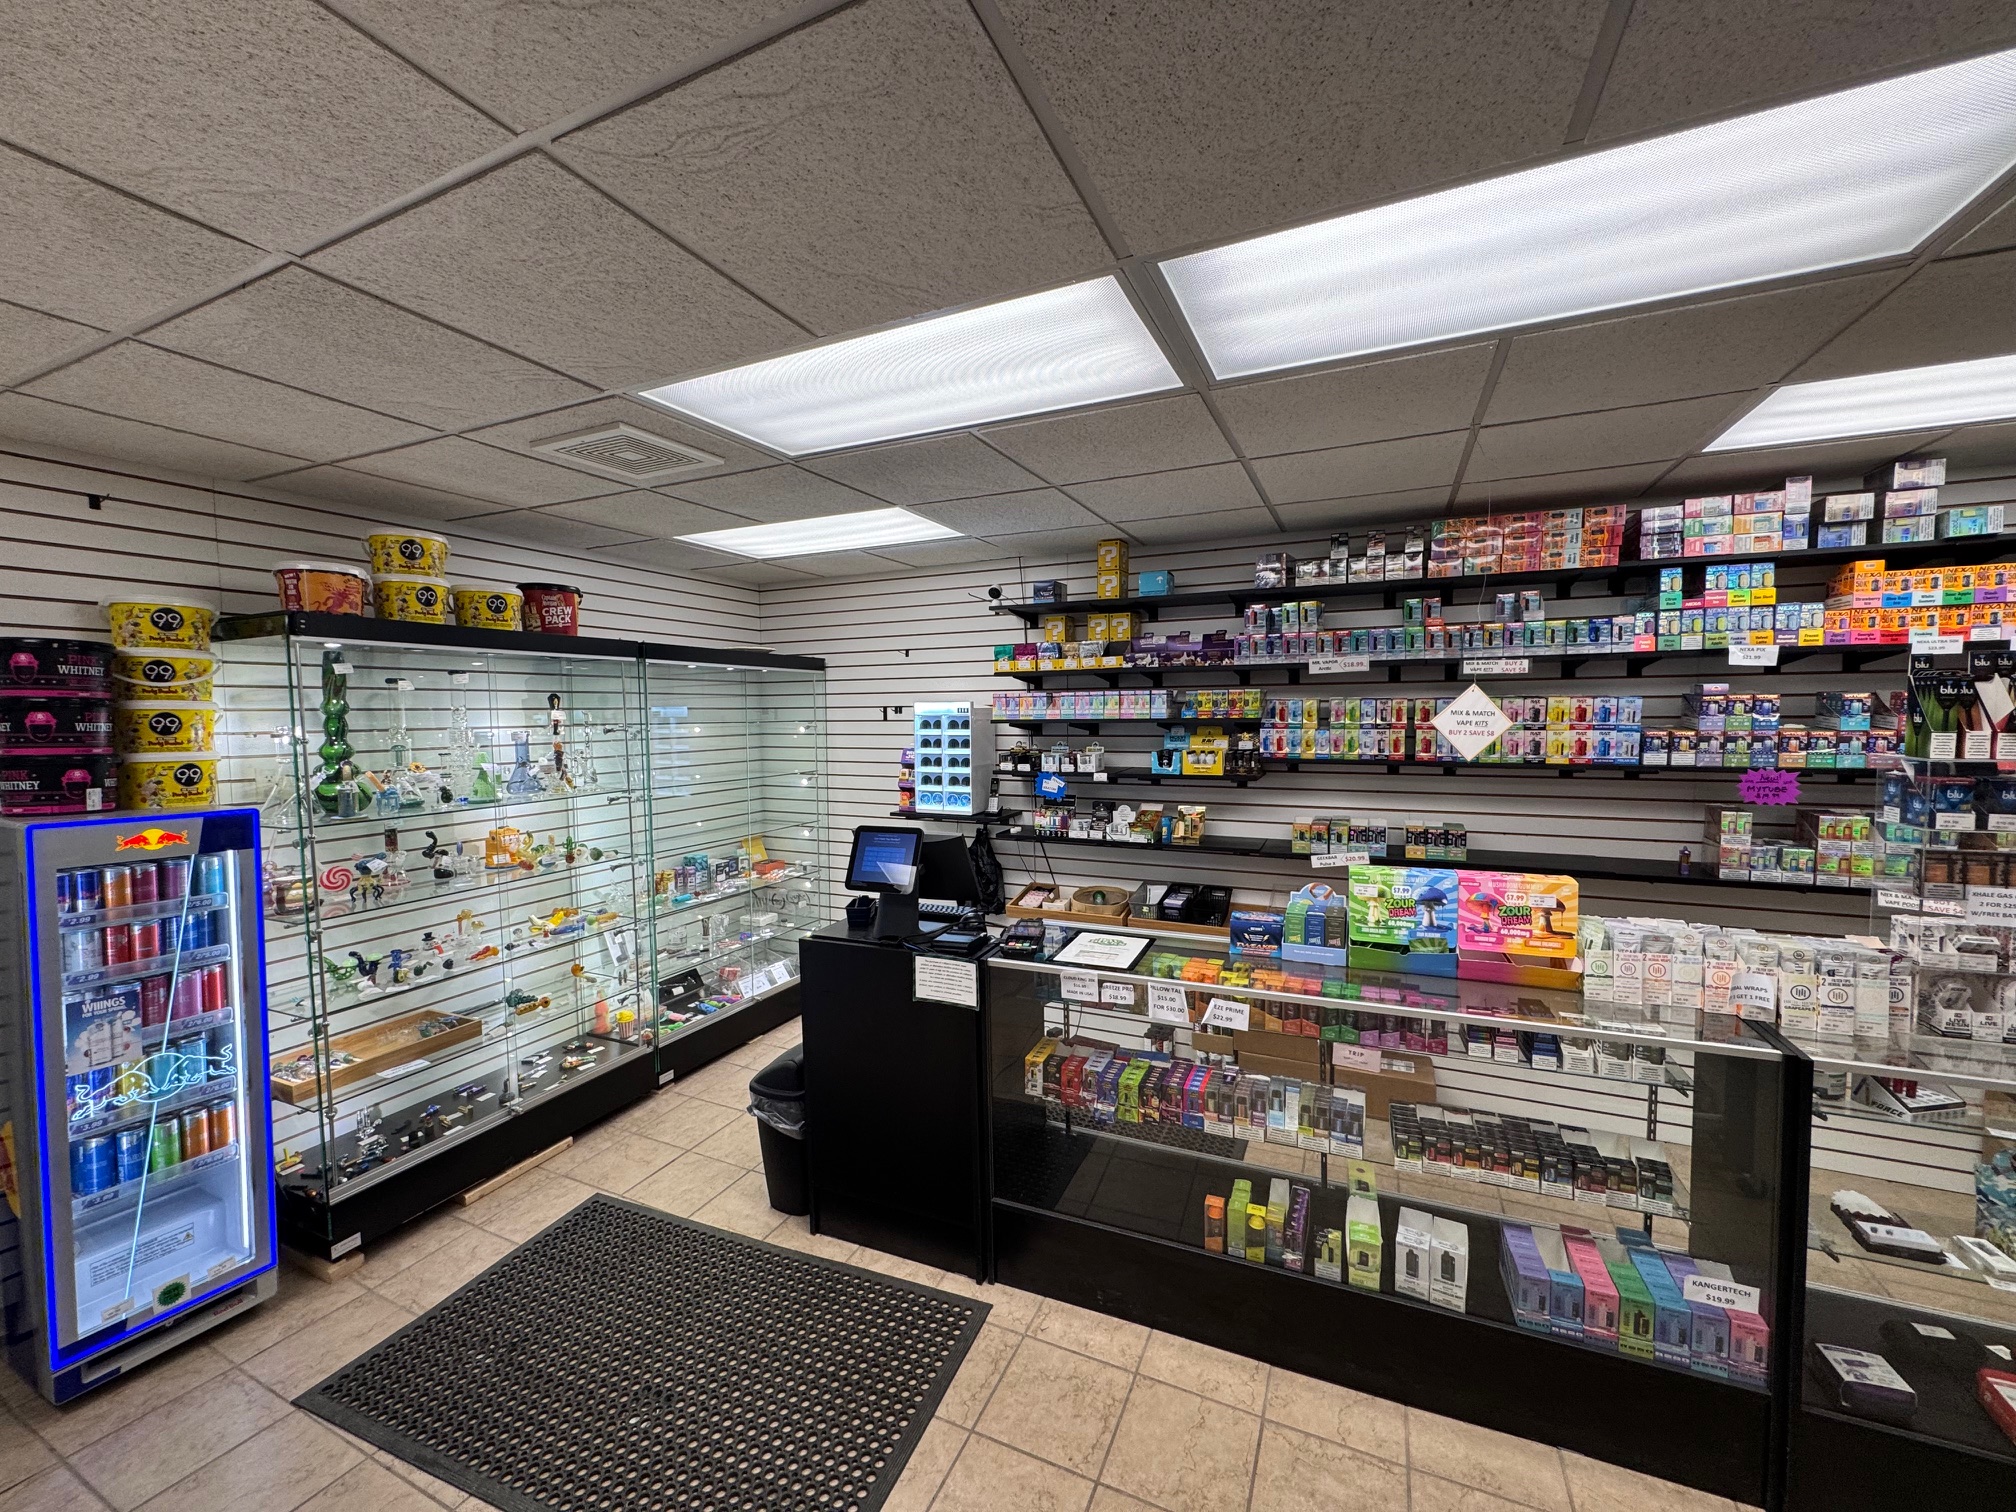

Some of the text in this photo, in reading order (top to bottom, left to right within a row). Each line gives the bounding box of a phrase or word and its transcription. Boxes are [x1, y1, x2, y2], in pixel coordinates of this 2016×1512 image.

[401, 543, 422, 557] 99
[418, 591, 436, 603] 99
[488, 599, 505, 610] 99
[542, 606, 572, 616] CREW
[1911, 606, 1937, 614] NEXA
[153, 612, 180, 628] 99
[545, 615, 571, 623] PACK
[67, 655, 99, 664] PINK
[1915, 660, 1929, 668] blu
[1998, 658, 2012, 666] blu
[58, 665, 104, 676] WHITNEY
[145, 665, 173, 680] 99
[1940, 685, 1957, 694] blu
[1914, 713, 1922, 723] blu
[152, 717, 179, 733] 99
[176, 768, 201, 783] 99
[1947, 790, 1963, 799] blu
[1506, 893, 1525, 901] $7.99
[1386, 899, 1415, 909] ZOUR
[1885, 899, 1900, 907] VAPE
[1389, 909, 1417, 918] DREAM
[1499, 906, 1531, 916] ZOUR
[1929, 905, 1950, 913] SAVE
[1971, 910, 1998, 918] W/FREE
[1501, 916, 1532, 926] DREAM
[1501, 928, 1530, 937] 60,000mg
[1236, 942, 1278, 950] TWEAKER
[1707, 961, 1711, 969] 2
[1821, 978, 1826, 986] 2
[1744, 985, 1768, 993] WRAPS
[1157, 995, 1176, 1003] $15.00
[82, 996, 126, 1013] WIIINGS
[1166, 1005, 1185, 1014] $30.00
[1225, 1005, 1244, 1015] PRIME
[1213, 1014, 1233, 1022] $22.99
[1871, 1101, 1905, 1118] FORCE
[1692, 1280, 1751, 1297] KANGERTECH
[1706, 1294, 1735, 1305] $19.99
